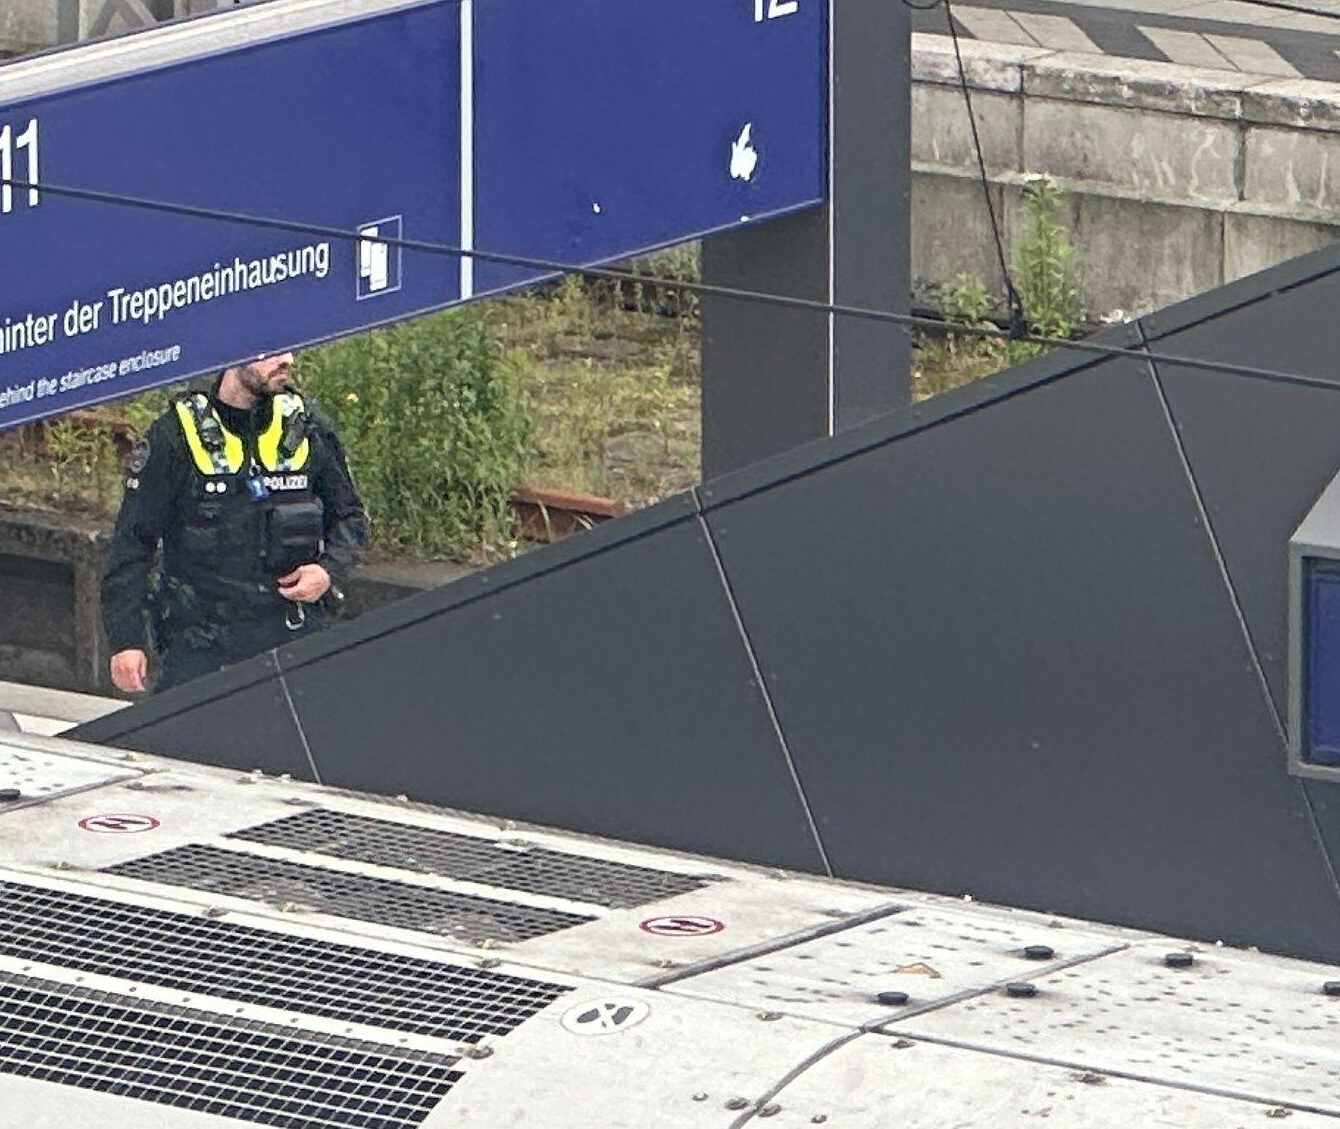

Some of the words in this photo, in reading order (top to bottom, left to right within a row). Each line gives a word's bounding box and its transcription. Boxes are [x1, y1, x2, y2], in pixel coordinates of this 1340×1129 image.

[63, 300, 104, 338] der
[107, 242, 330, 325] Treppeneinhausung
[36, 376, 59, 398] the
[59, 360, 117, 392] staircase
[119, 344, 181, 376] enclosure
[263, 474, 308, 491] POLIZEI
